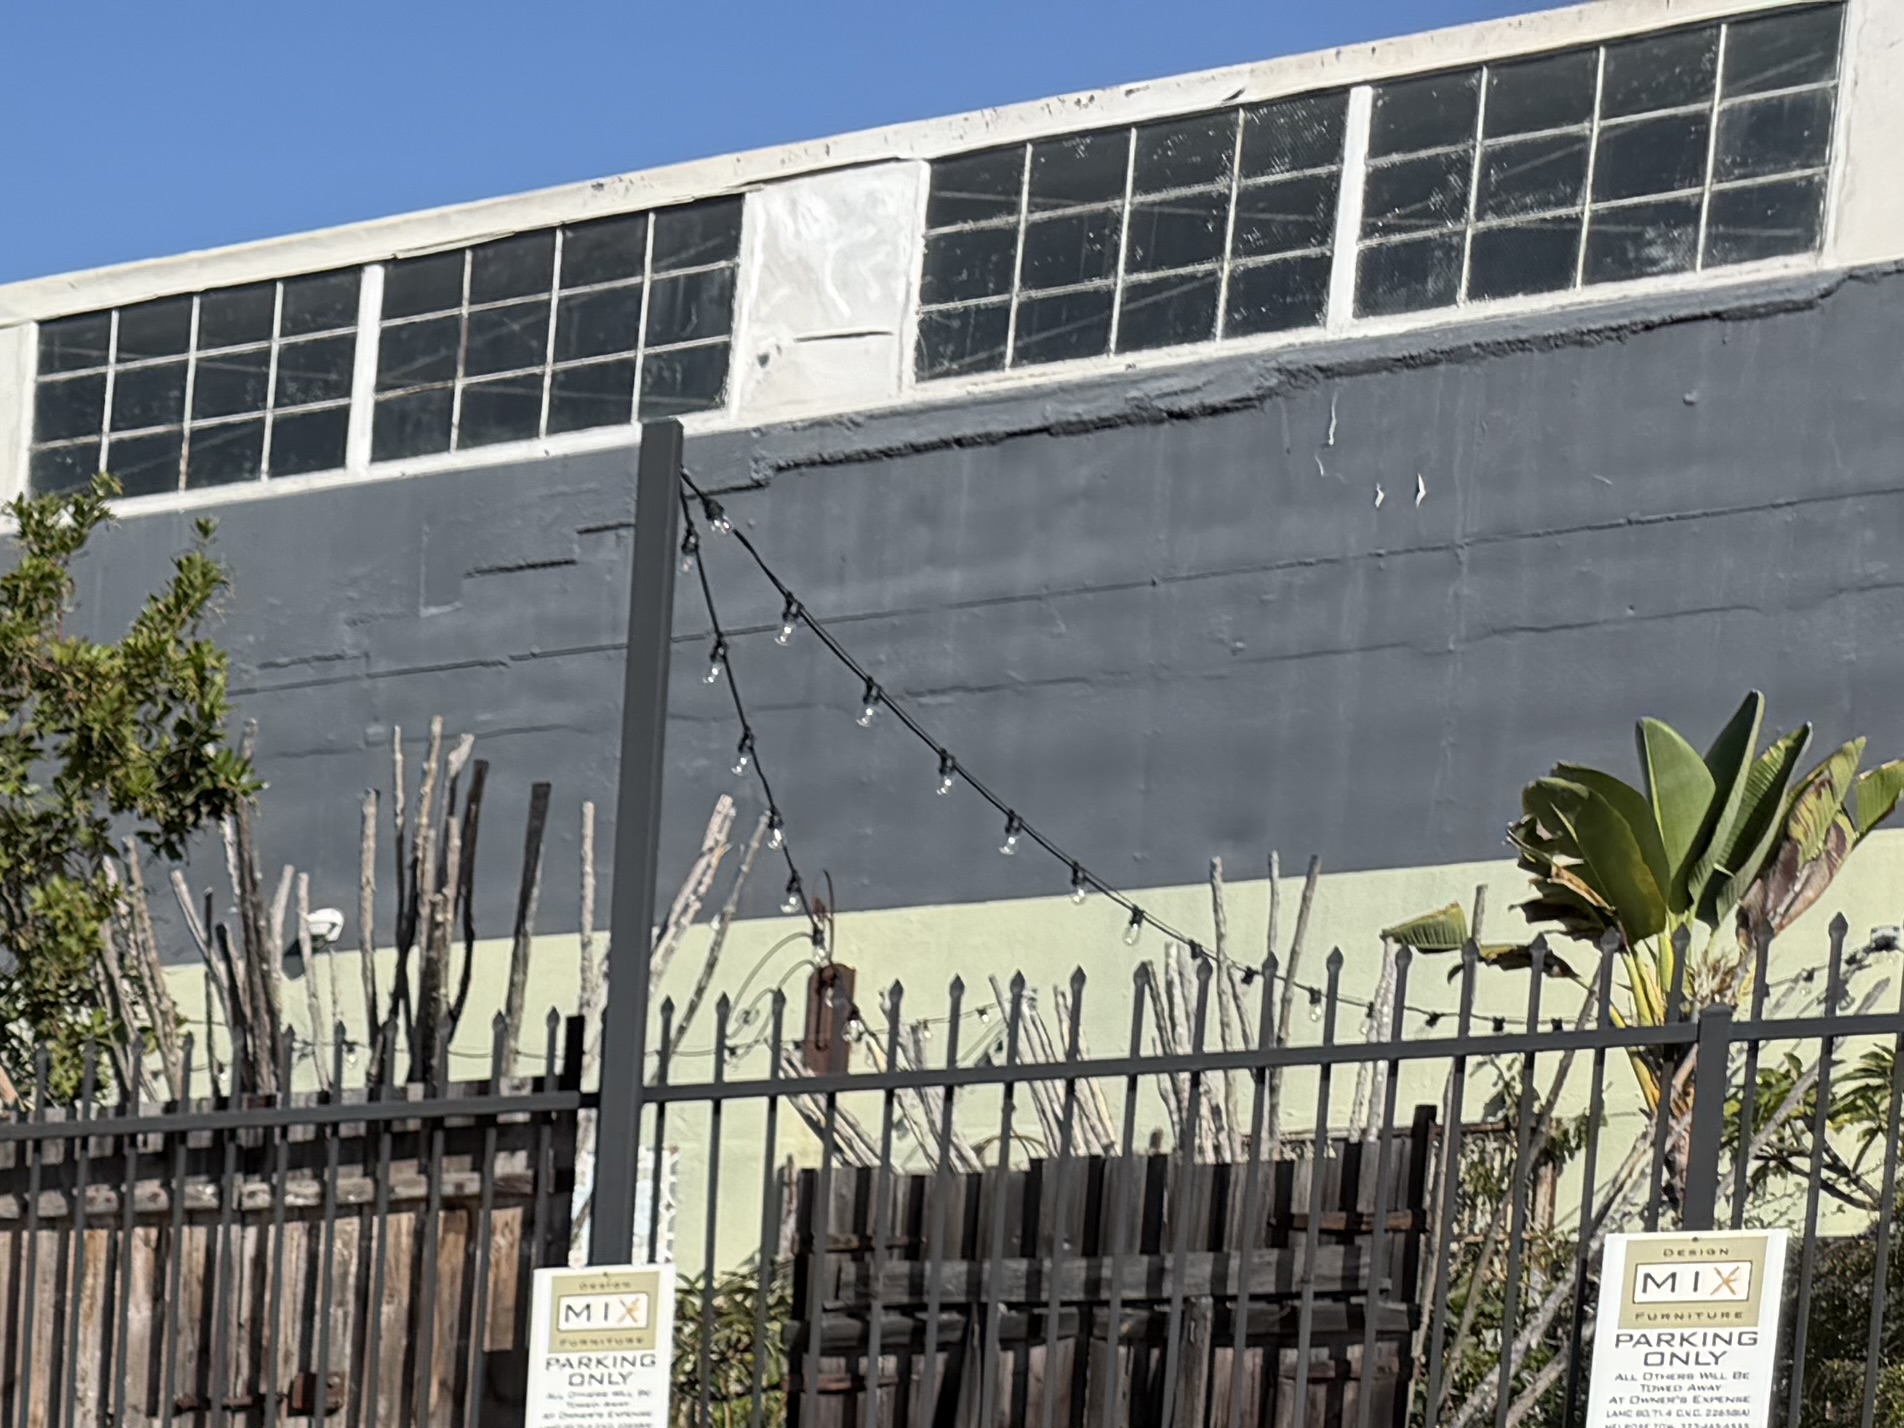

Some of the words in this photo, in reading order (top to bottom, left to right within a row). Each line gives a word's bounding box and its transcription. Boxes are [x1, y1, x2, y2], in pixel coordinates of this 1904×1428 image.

[1663, 1247, 1730, 1258] DESIGN
[1641, 1266, 1741, 1296] MIX
[564, 1298, 640, 1323] MIX
[1635, 1311, 1744, 1322] FURNITURE
[1615, 1331, 1759, 1349] PARKING
[545, 1354, 657, 1371] PARKING
[1643, 1351, 1727, 1368] ONLY
[568, 1371, 633, 1387] ONLY
